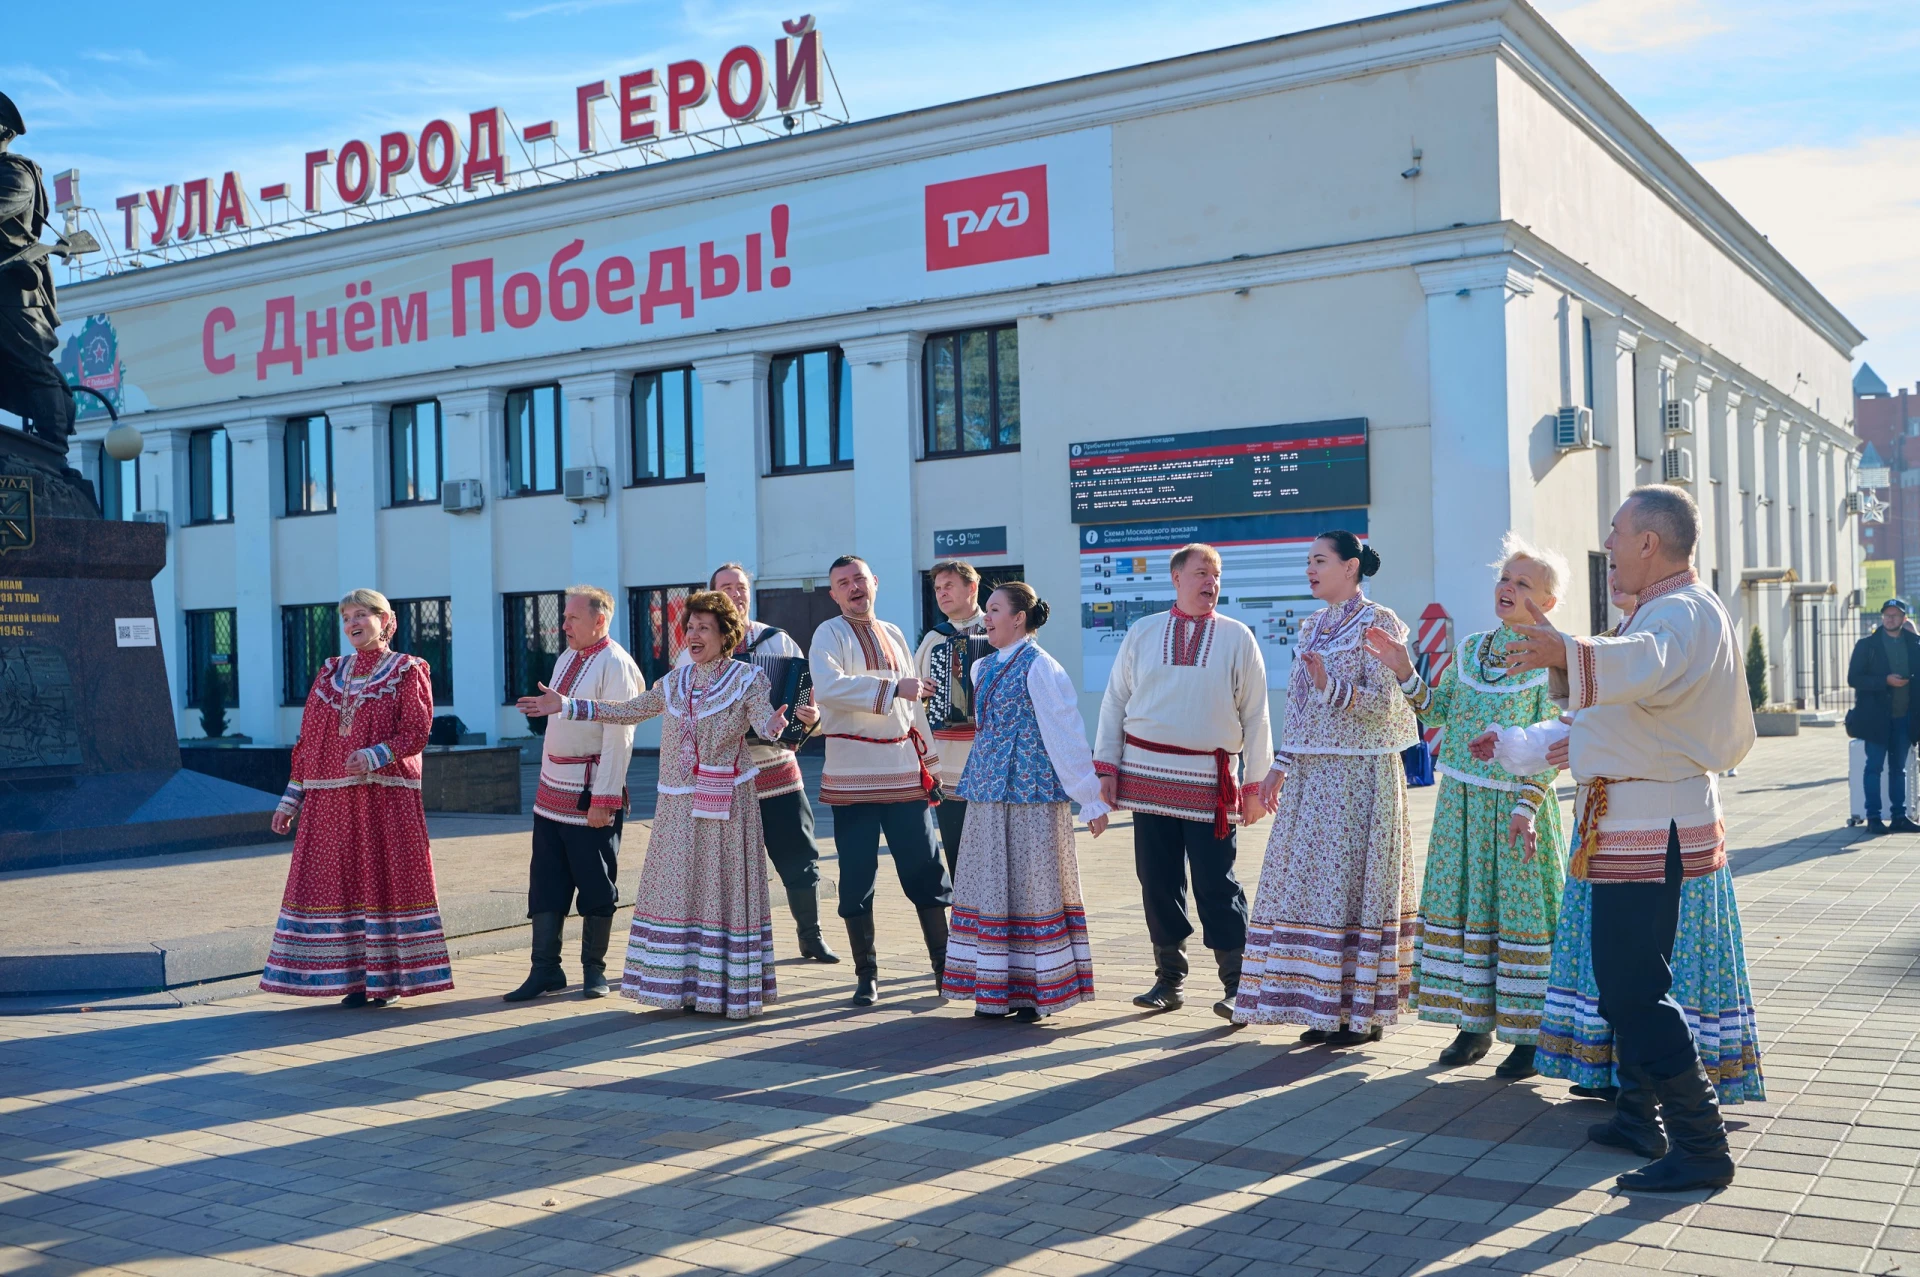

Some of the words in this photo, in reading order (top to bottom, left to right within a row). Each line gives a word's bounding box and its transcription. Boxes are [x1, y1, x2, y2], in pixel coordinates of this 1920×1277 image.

[116, 171, 251, 250] ТУЛА
[305, 106, 510, 212] ГОРОД
[577, 13, 823, 153] ГЕРОЙ
[202, 305, 235, 375] С
[256, 280, 428, 381] Днём
[451, 204, 793, 339] Победы!
[1104, 529, 1124, 537] Схема
[1125, 526, 1169, 536] Московского
[1170, 525, 1198, 533] вокзала
[946, 533, 966, 546] 6-9
[967, 532, 981, 540] Пути
[31, 613, 60, 623] ВОЙНЫ
